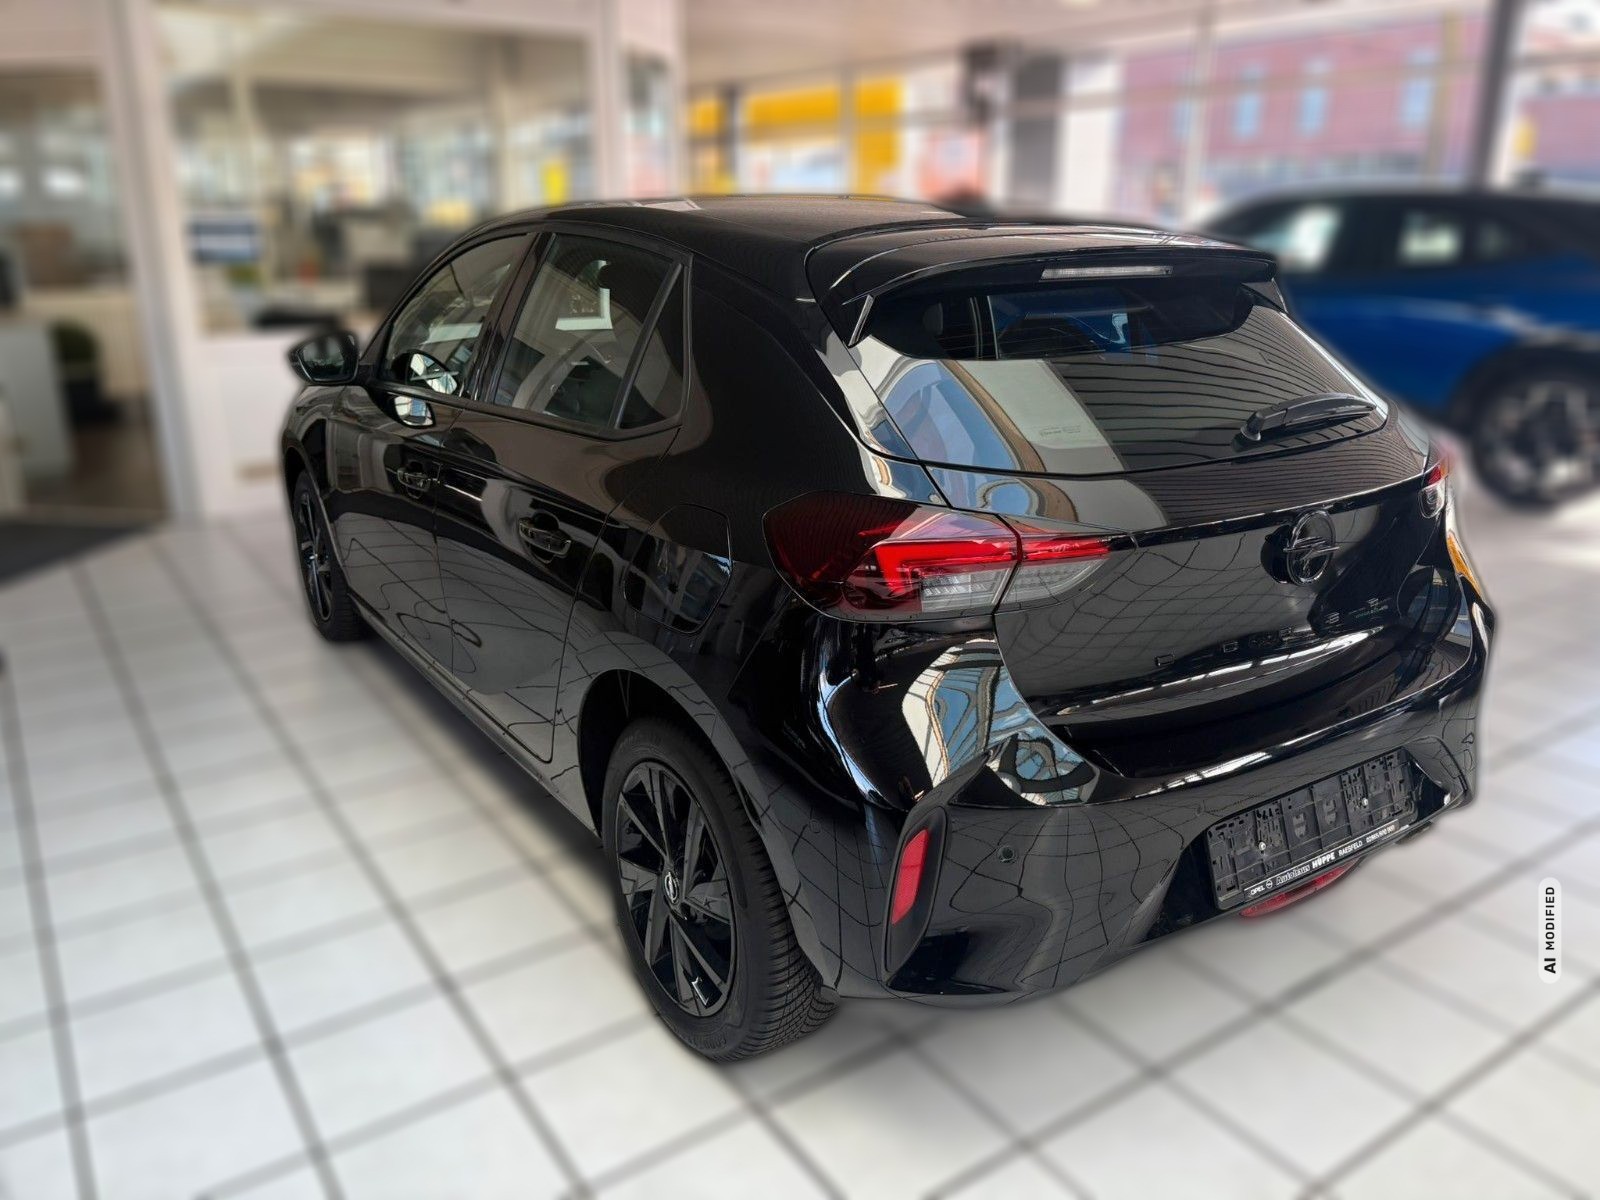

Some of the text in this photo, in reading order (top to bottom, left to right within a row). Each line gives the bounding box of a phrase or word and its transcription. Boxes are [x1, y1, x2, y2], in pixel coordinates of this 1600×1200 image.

[1250, 885, 1265, 896] OPEL
[1311, 852, 1336, 869] HÜPPE
[1338, 840, 1363, 857] RAESFELD
